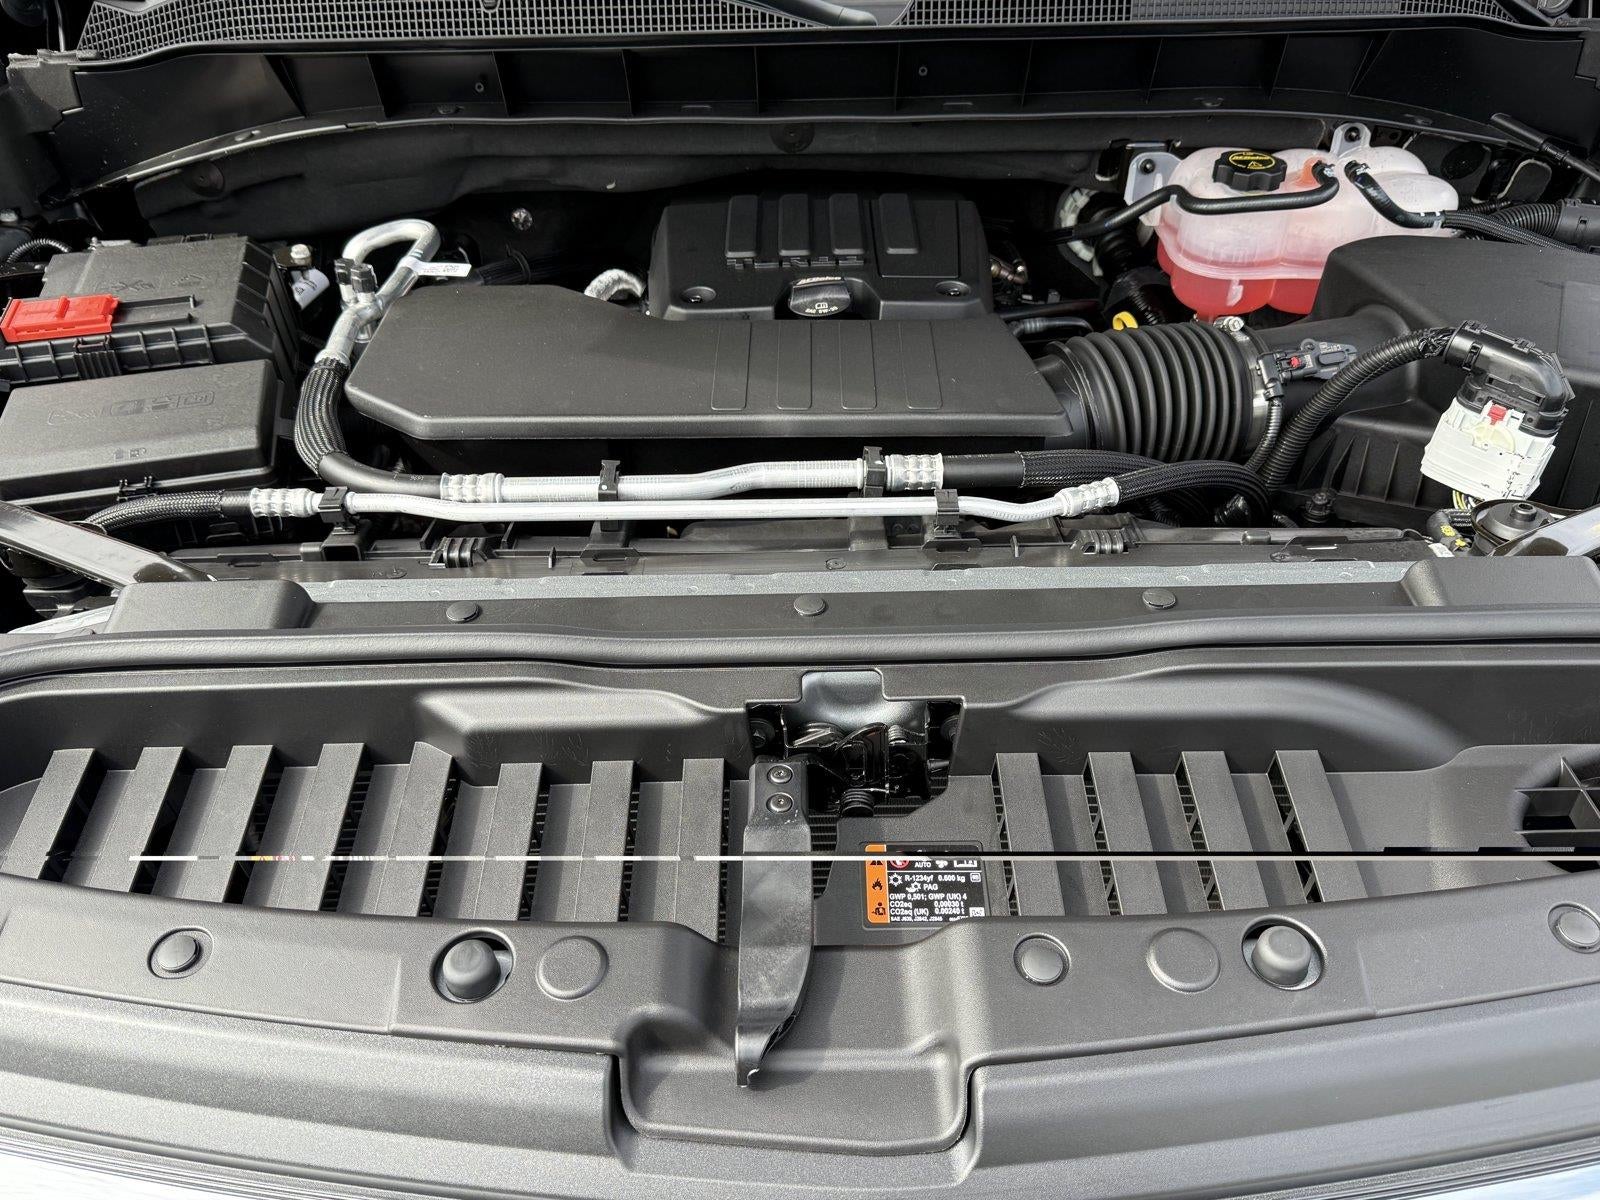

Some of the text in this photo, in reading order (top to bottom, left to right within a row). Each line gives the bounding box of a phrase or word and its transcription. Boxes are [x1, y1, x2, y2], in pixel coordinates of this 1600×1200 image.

[904, 874, 934, 882] R-1234yf
[957, 874, 966, 883] kg
[946, 893, 961, 901] (UK)
[890, 908, 912, 916] CO2eq
[914, 908, 929, 916] (UK)
